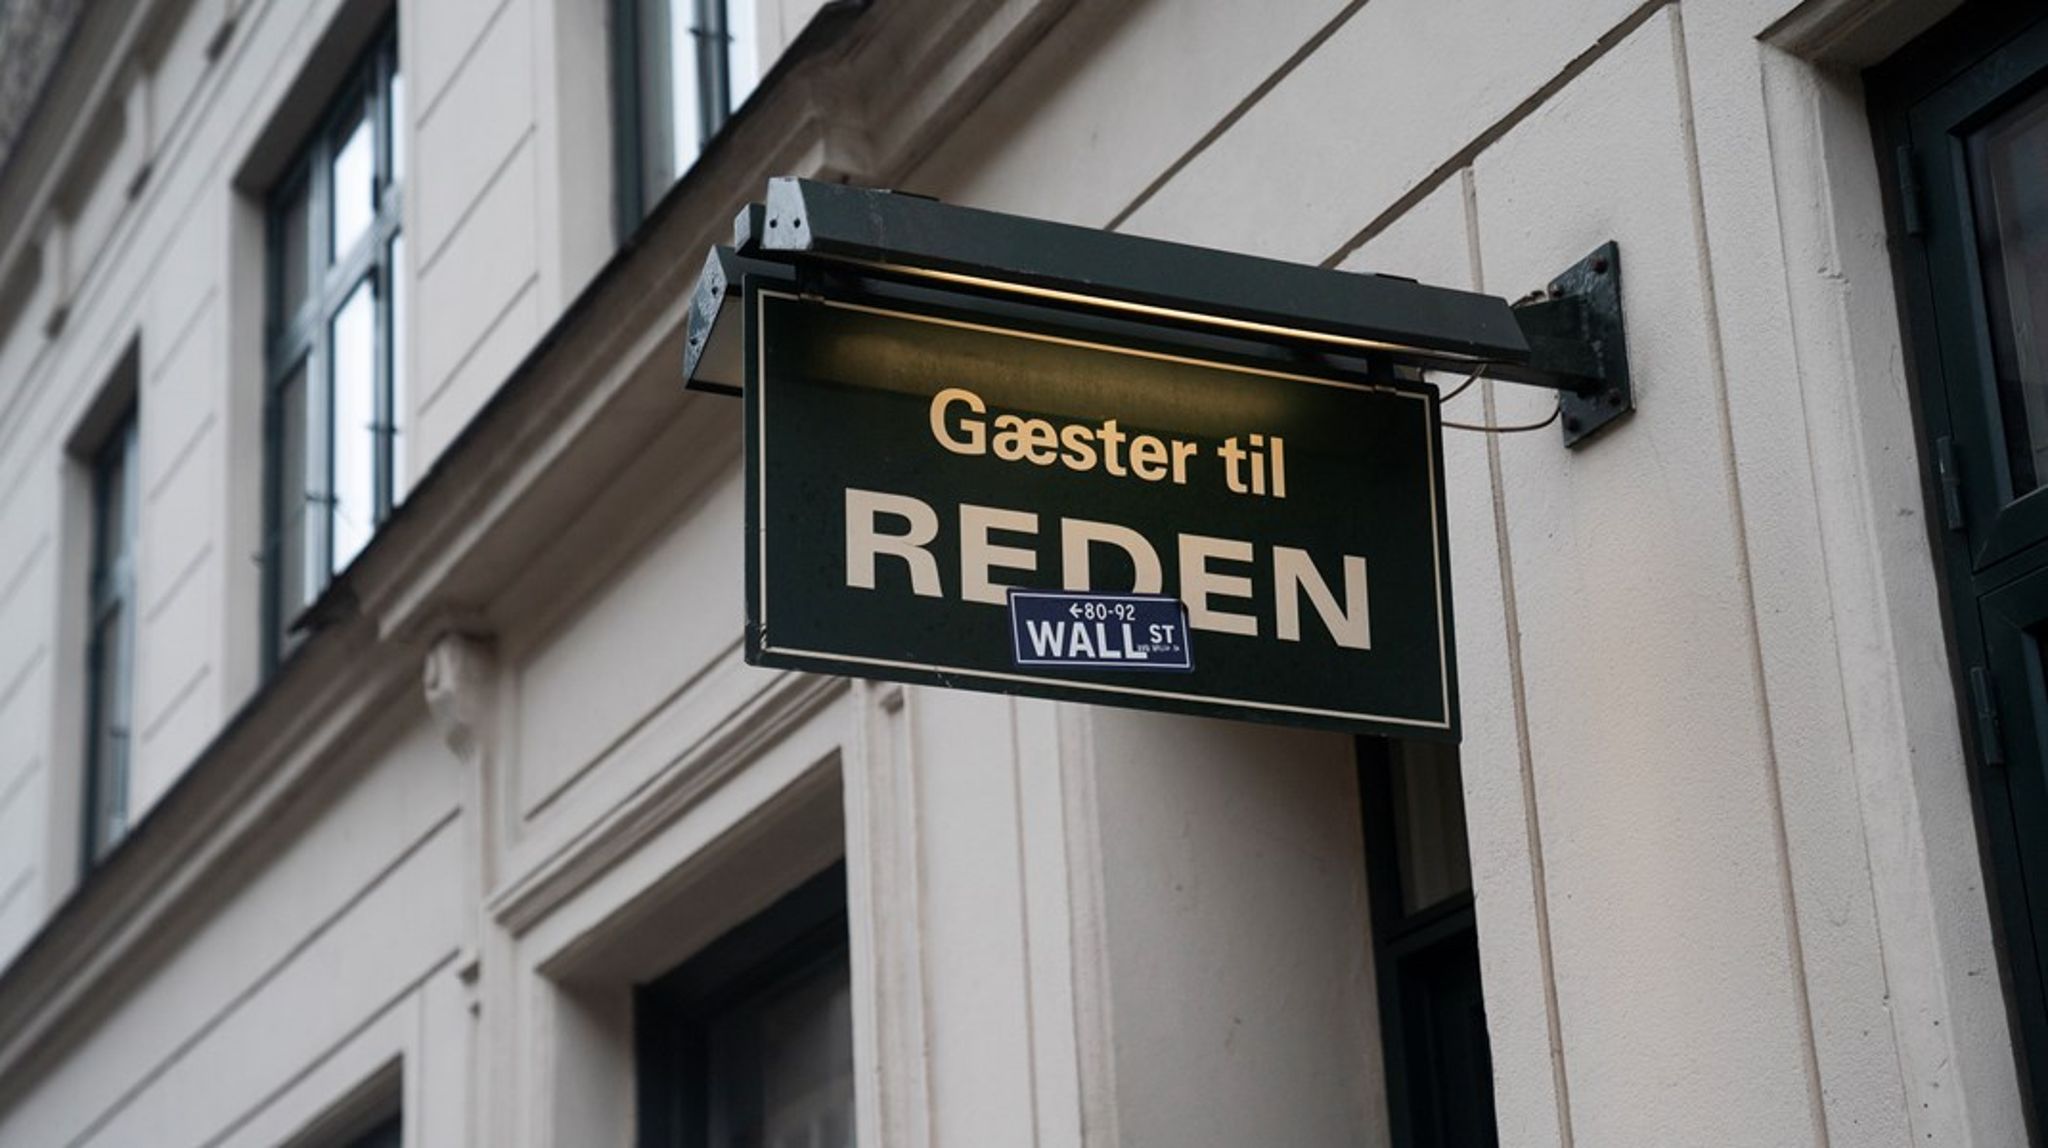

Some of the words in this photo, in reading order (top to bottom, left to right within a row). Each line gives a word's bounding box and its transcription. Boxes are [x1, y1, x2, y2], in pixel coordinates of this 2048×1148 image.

[929, 387, 1198, 485] Gæster
[1217, 434, 1286, 499] til
[844, 486, 1372, 651] REDEN
[1025, 619, 1150, 660] WALL
[1148, 623, 1175, 644] ST
[1084, 602, 1136, 621] 80-92
